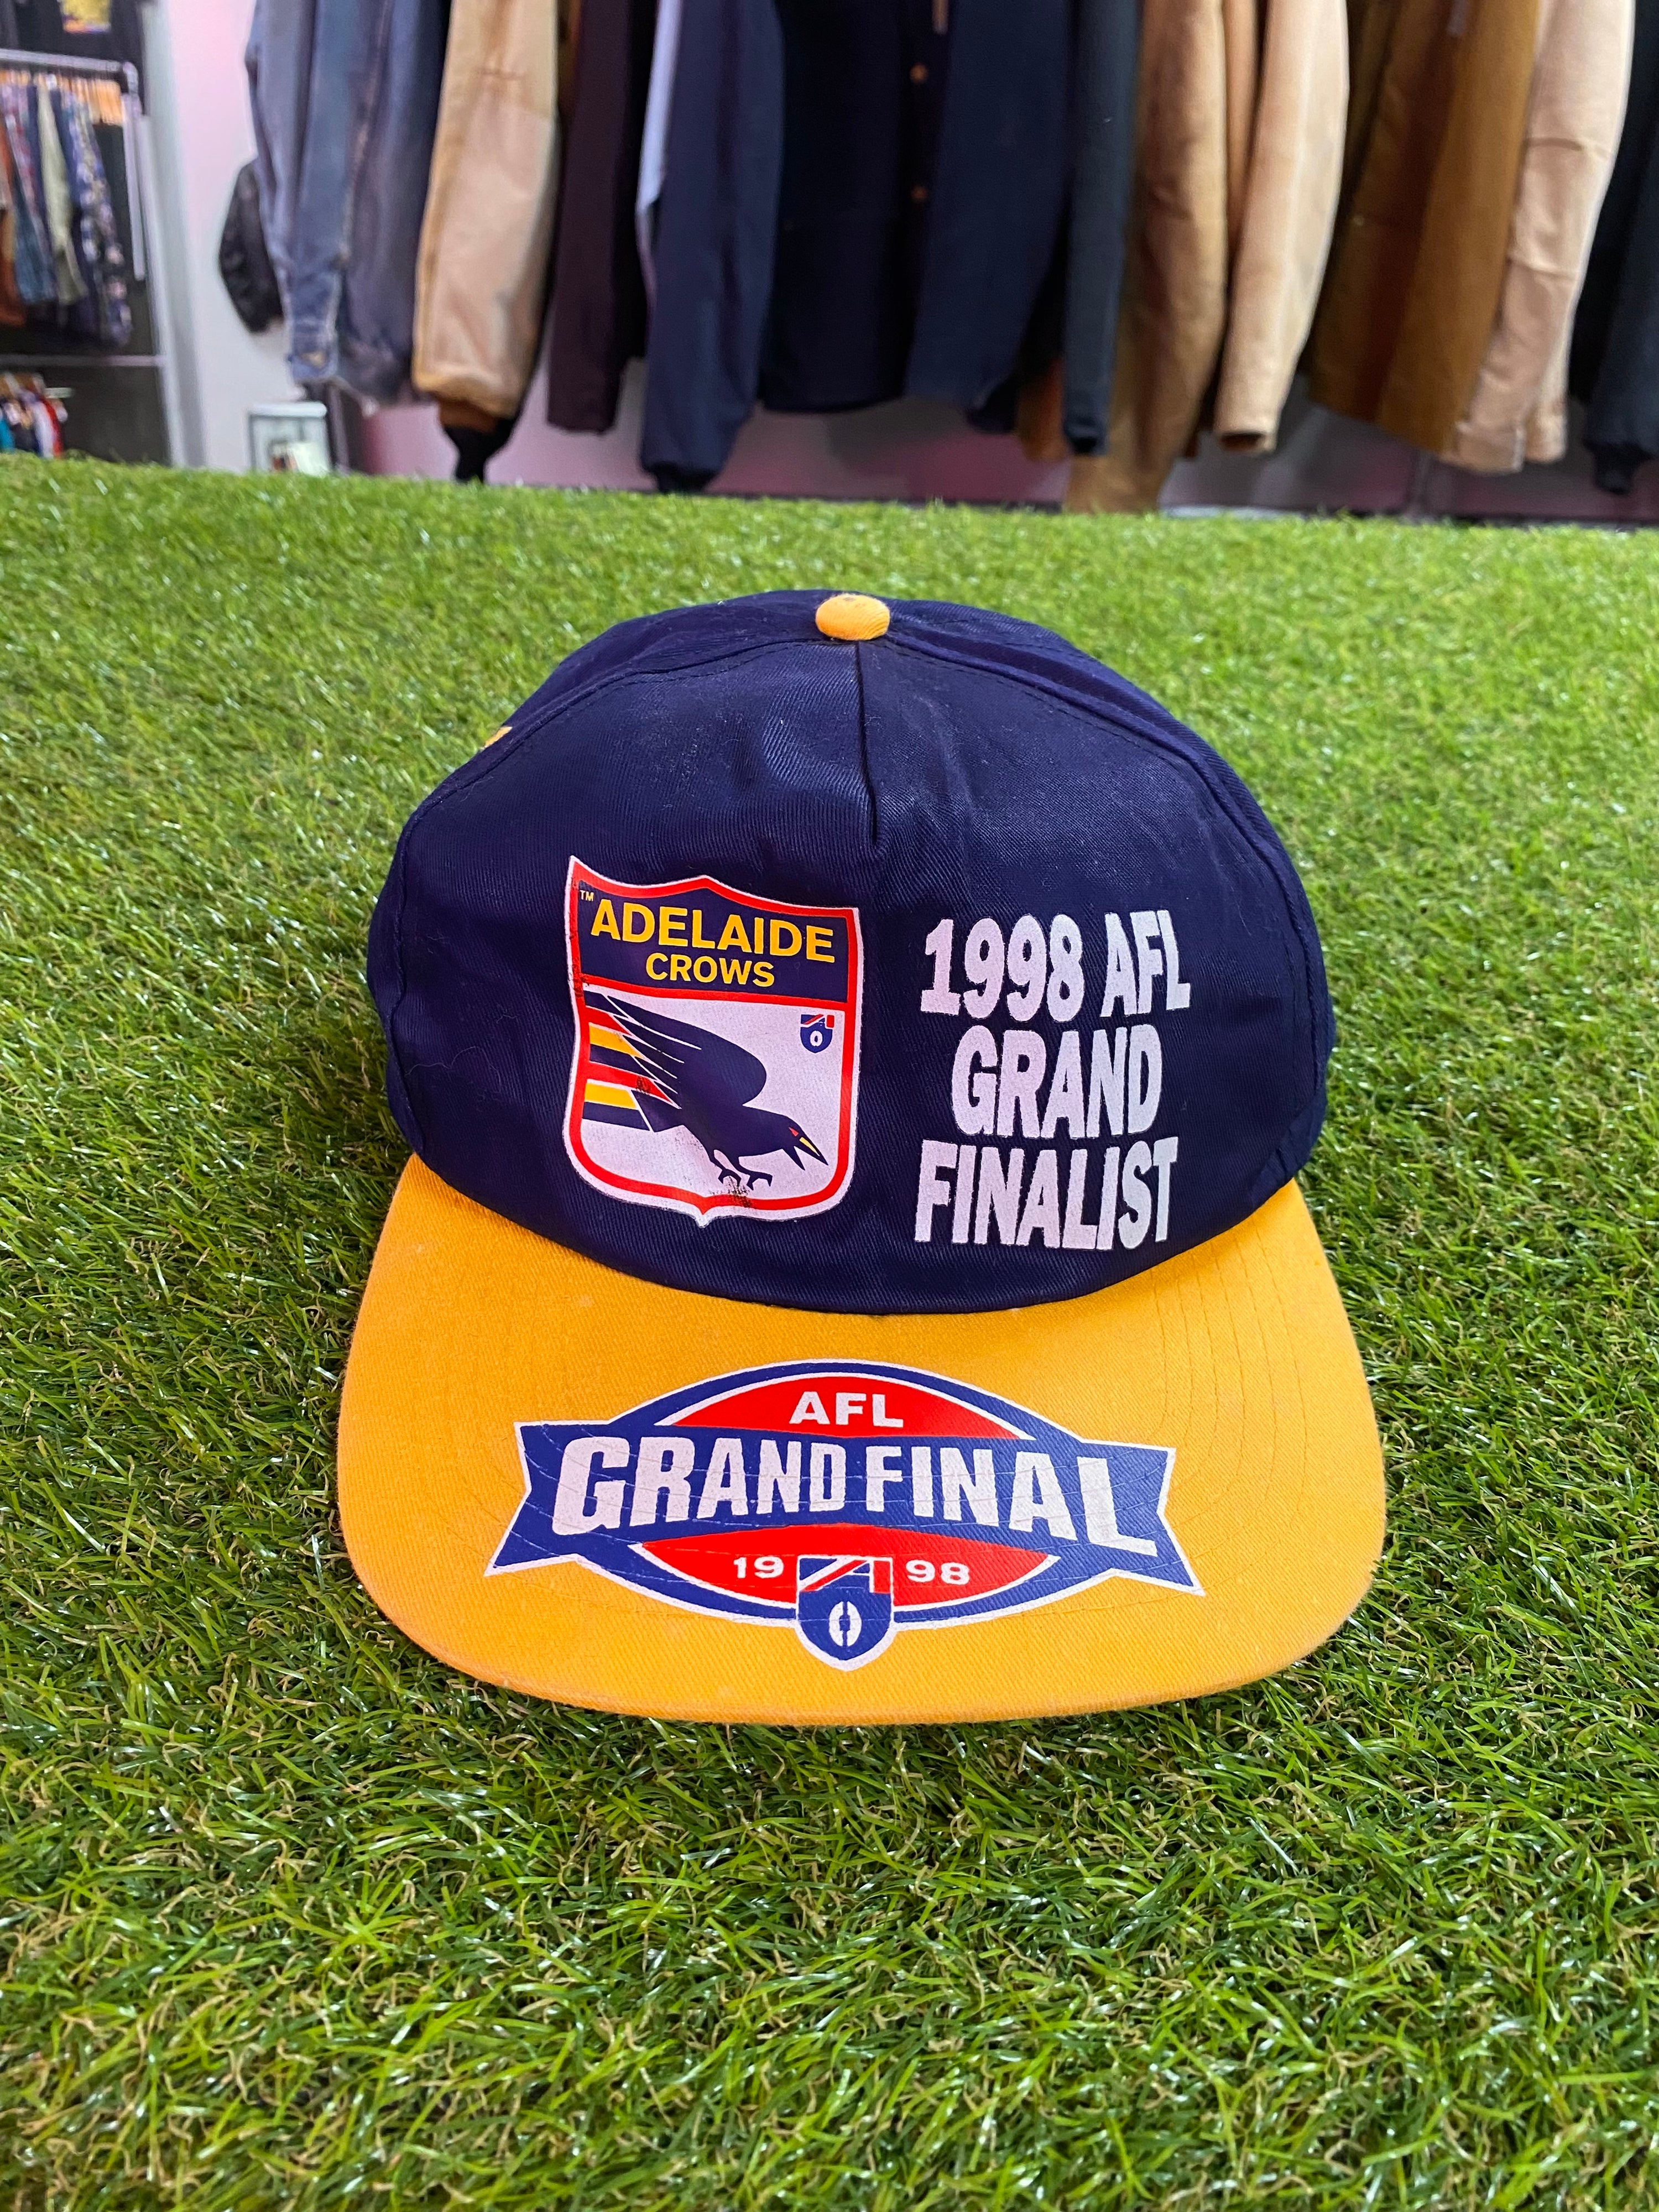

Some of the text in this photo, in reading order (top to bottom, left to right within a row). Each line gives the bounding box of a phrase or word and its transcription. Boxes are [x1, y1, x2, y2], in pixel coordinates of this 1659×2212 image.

[591, 899, 835, 963] ADELAIDE
[645, 953, 775, 987] CROWS
[920, 909, 1191, 1022] 1998 AFL
[951, 1024, 1162, 1140] GRAND
[914, 1136, 1178, 1251] FINALIST
[789, 1391, 904, 1428] AFL
[551, 1435, 1159, 1557] GRAND FINAL
[733, 1555, 971, 1586] 19 98
